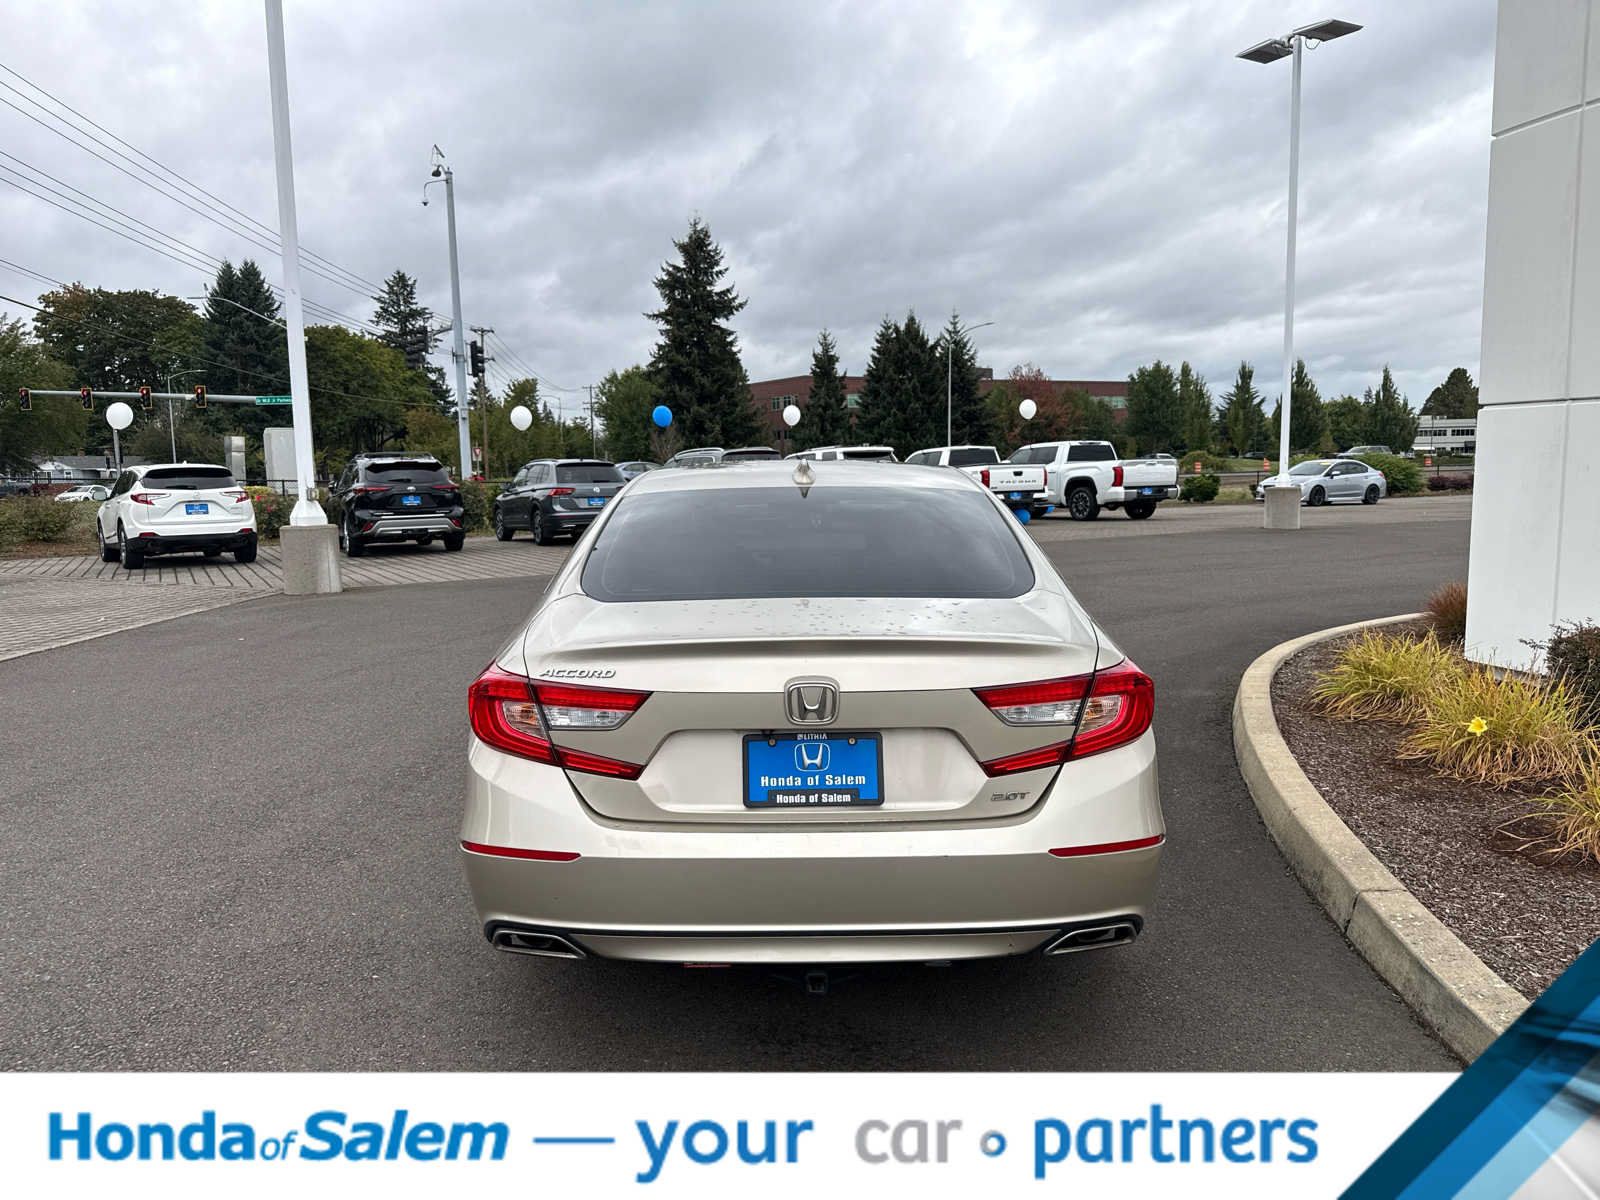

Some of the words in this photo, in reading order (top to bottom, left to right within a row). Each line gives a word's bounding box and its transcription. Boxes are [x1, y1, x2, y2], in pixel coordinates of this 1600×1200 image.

[540, 667, 617, 679] ACCORD
[760, 775, 801, 787] Honda
[807, 775, 819, 786] of
[825, 774, 866, 786] Salem
[776, 793, 806, 804] Honda
[809, 793, 818, 803] of
[821, 793, 851, 803] Salem
